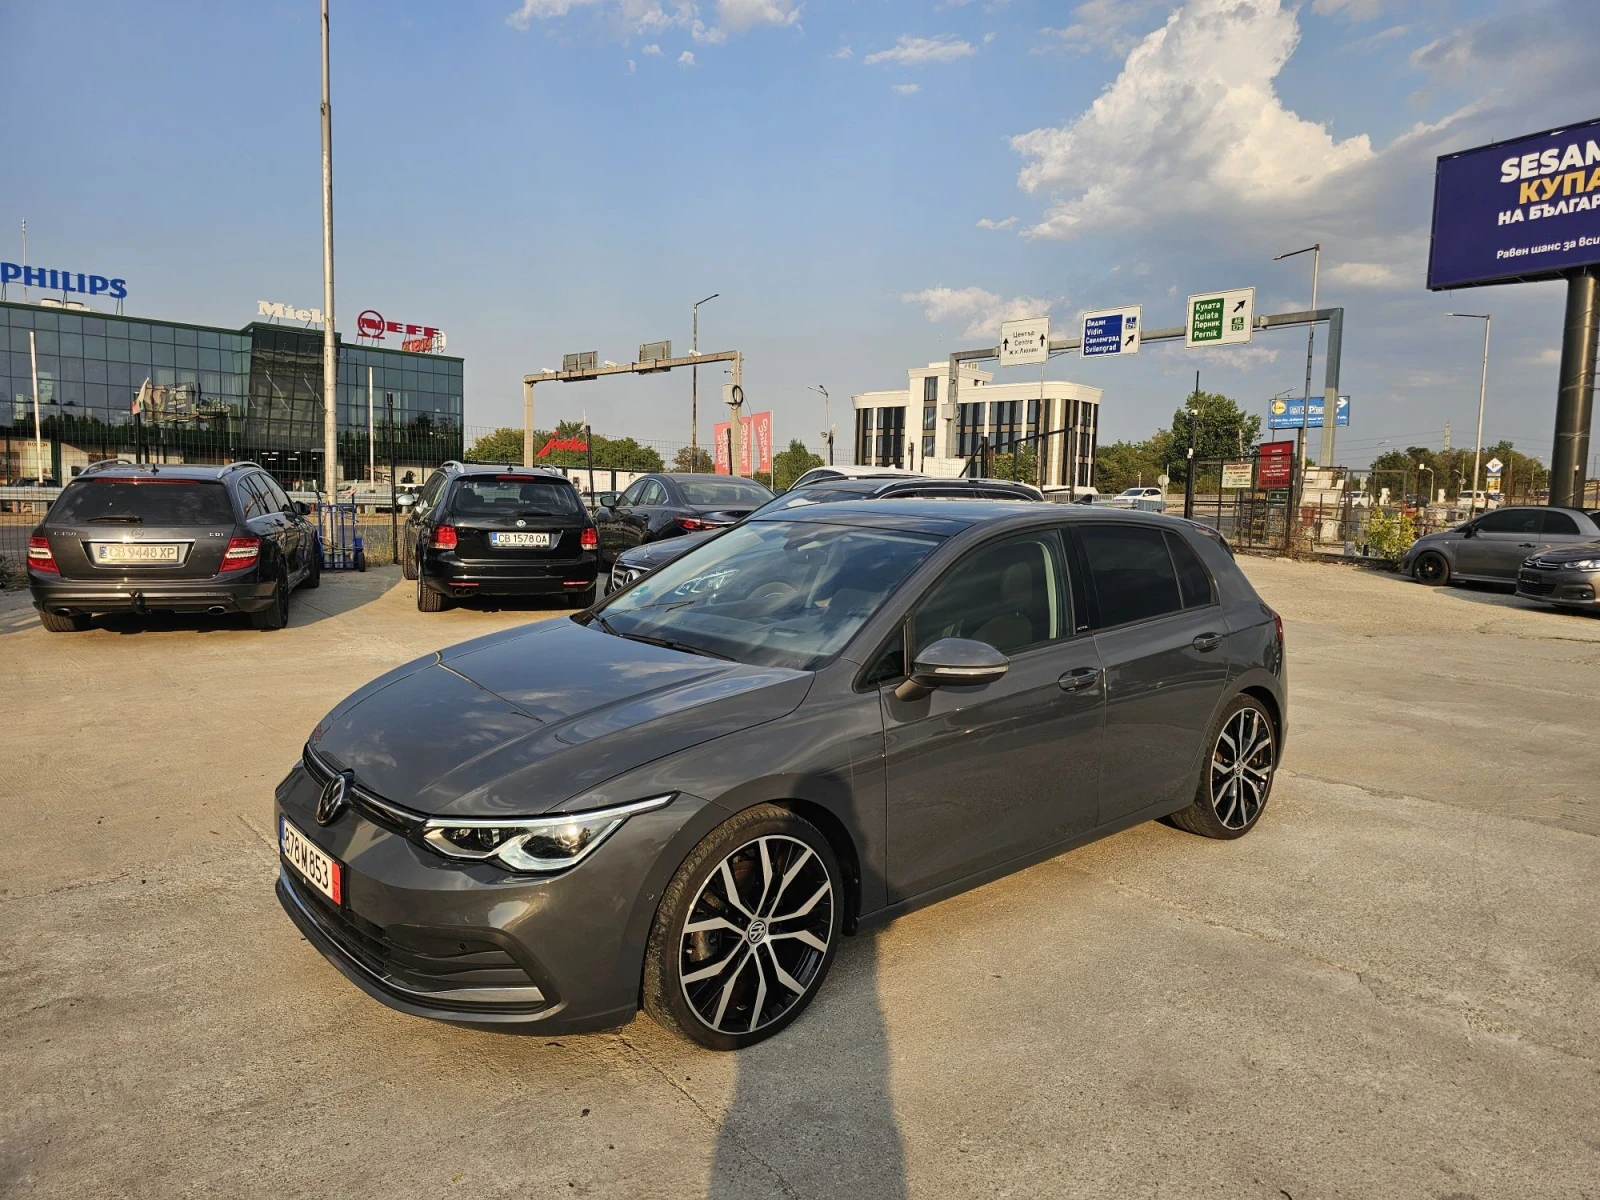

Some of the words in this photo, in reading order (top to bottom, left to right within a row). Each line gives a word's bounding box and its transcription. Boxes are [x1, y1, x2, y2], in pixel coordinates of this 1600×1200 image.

[1498, 208, 1525, 226] НА
[1496, 247, 1529, 259] Равен
[1530, 242, 1562, 254] шанс
[1562, 240, 1577, 251] за
[0, 262, 128, 299] PHILIPS
[1195, 302, 1221, 312] Кулата
[1195, 312, 1219, 320] Kulata
[359, 312, 440, 338] NEFF
[1087, 319, 1106, 327] Видин
[1194, 320, 1220, 329] Перник
[1012, 330, 1035, 338] Център
[1086, 328, 1103, 336] Vidin
[1194, 330, 1218, 339] Pernik
[498, 534, 510, 543] CB
[128, 547, 157, 558] 9448
[159, 547, 176, 558] XP
